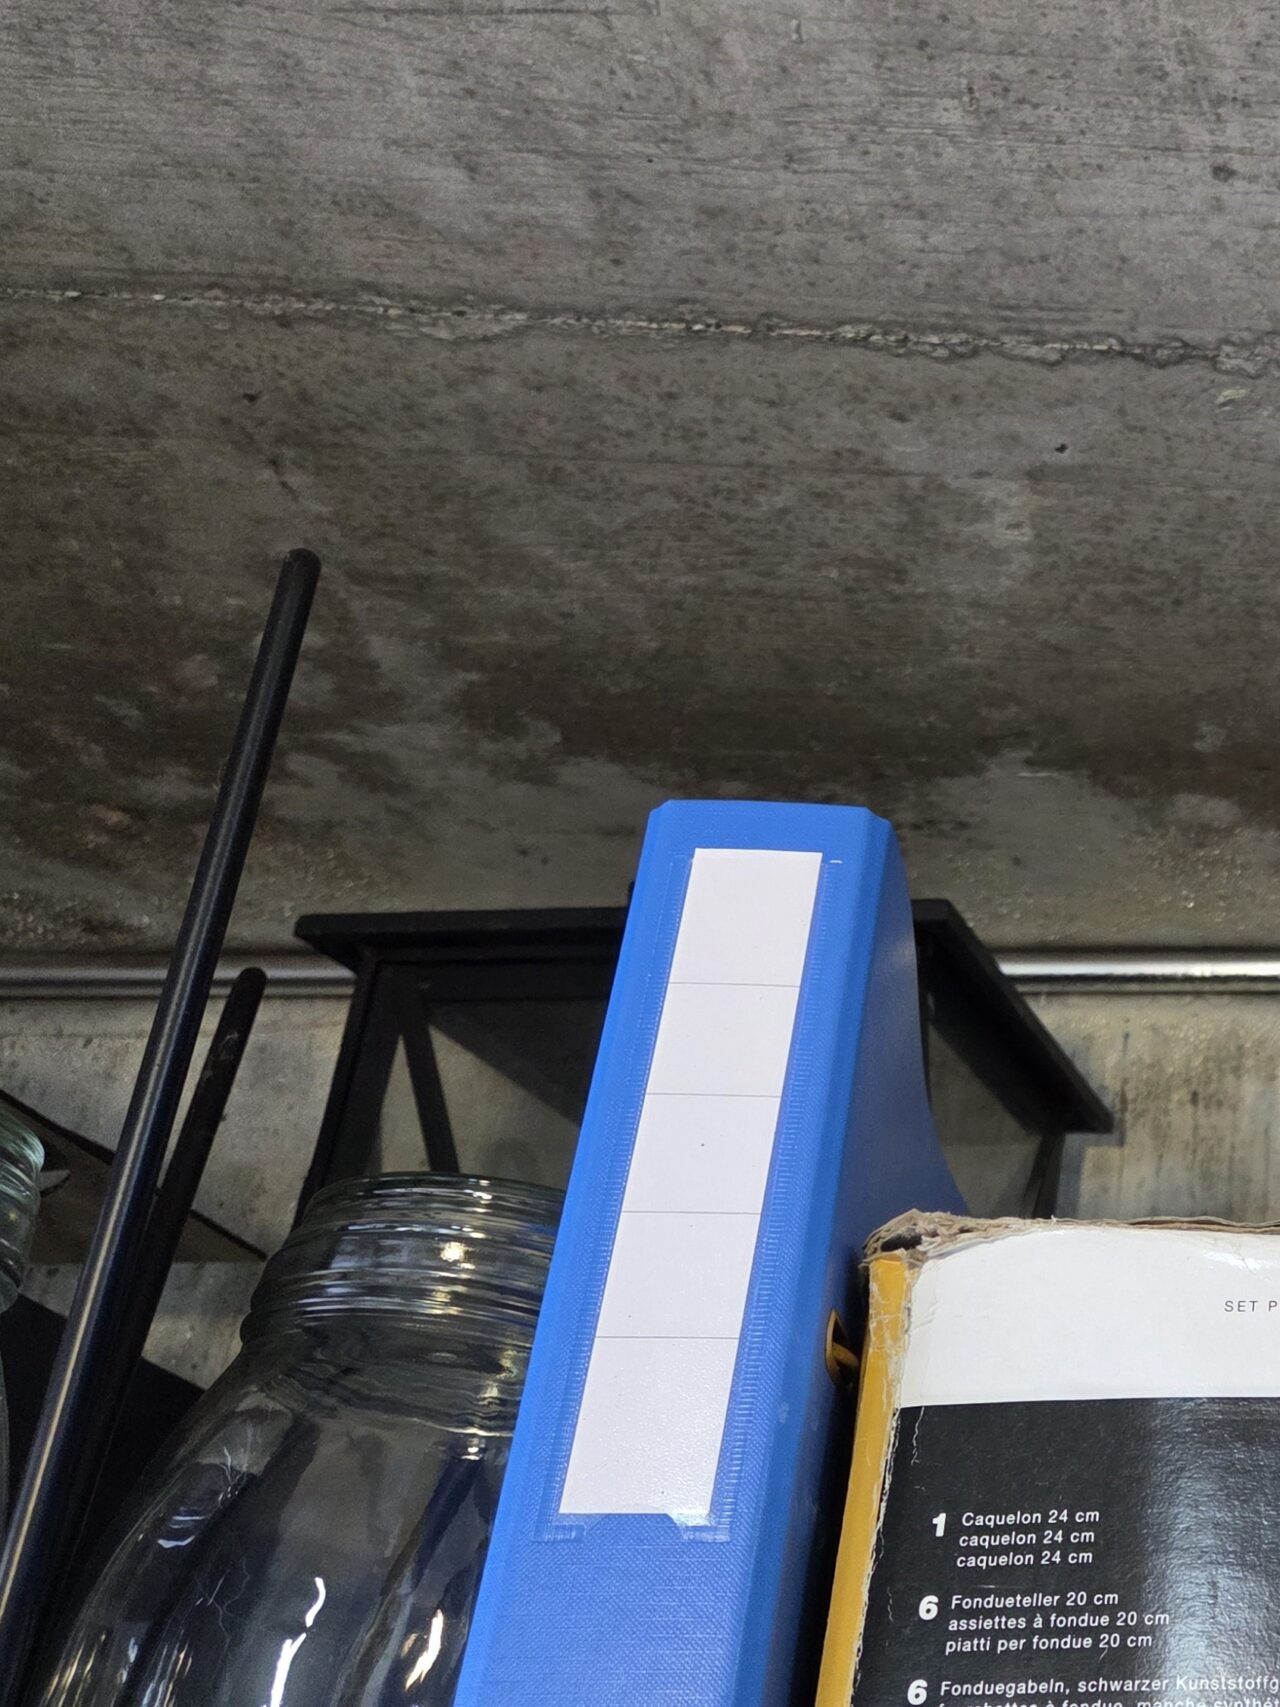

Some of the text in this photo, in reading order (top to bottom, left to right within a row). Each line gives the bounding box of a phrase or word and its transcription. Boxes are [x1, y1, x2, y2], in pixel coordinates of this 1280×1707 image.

[1224, 1300, 1259, 1313] SET
[932, 1509, 1100, 1537] 1 Caquelon 24 cm
[959, 1530, 1095, 1549] caquelon 24 cm
[956, 1551, 1093, 1570] caquelon 24 cm
[918, 1591, 1119, 1620] 6 Fondueteller 20 cm
[948, 1611, 1170, 1631] assiettes à fondue 20 cm
[945, 1633, 1152, 1656] piatti per fondue 20 cm
[907, 1679, 928, 1706] 6
[940, 1678, 1070, 1698] Fonduegabeln,
[1077, 1677, 1168, 1693] schwarzer
